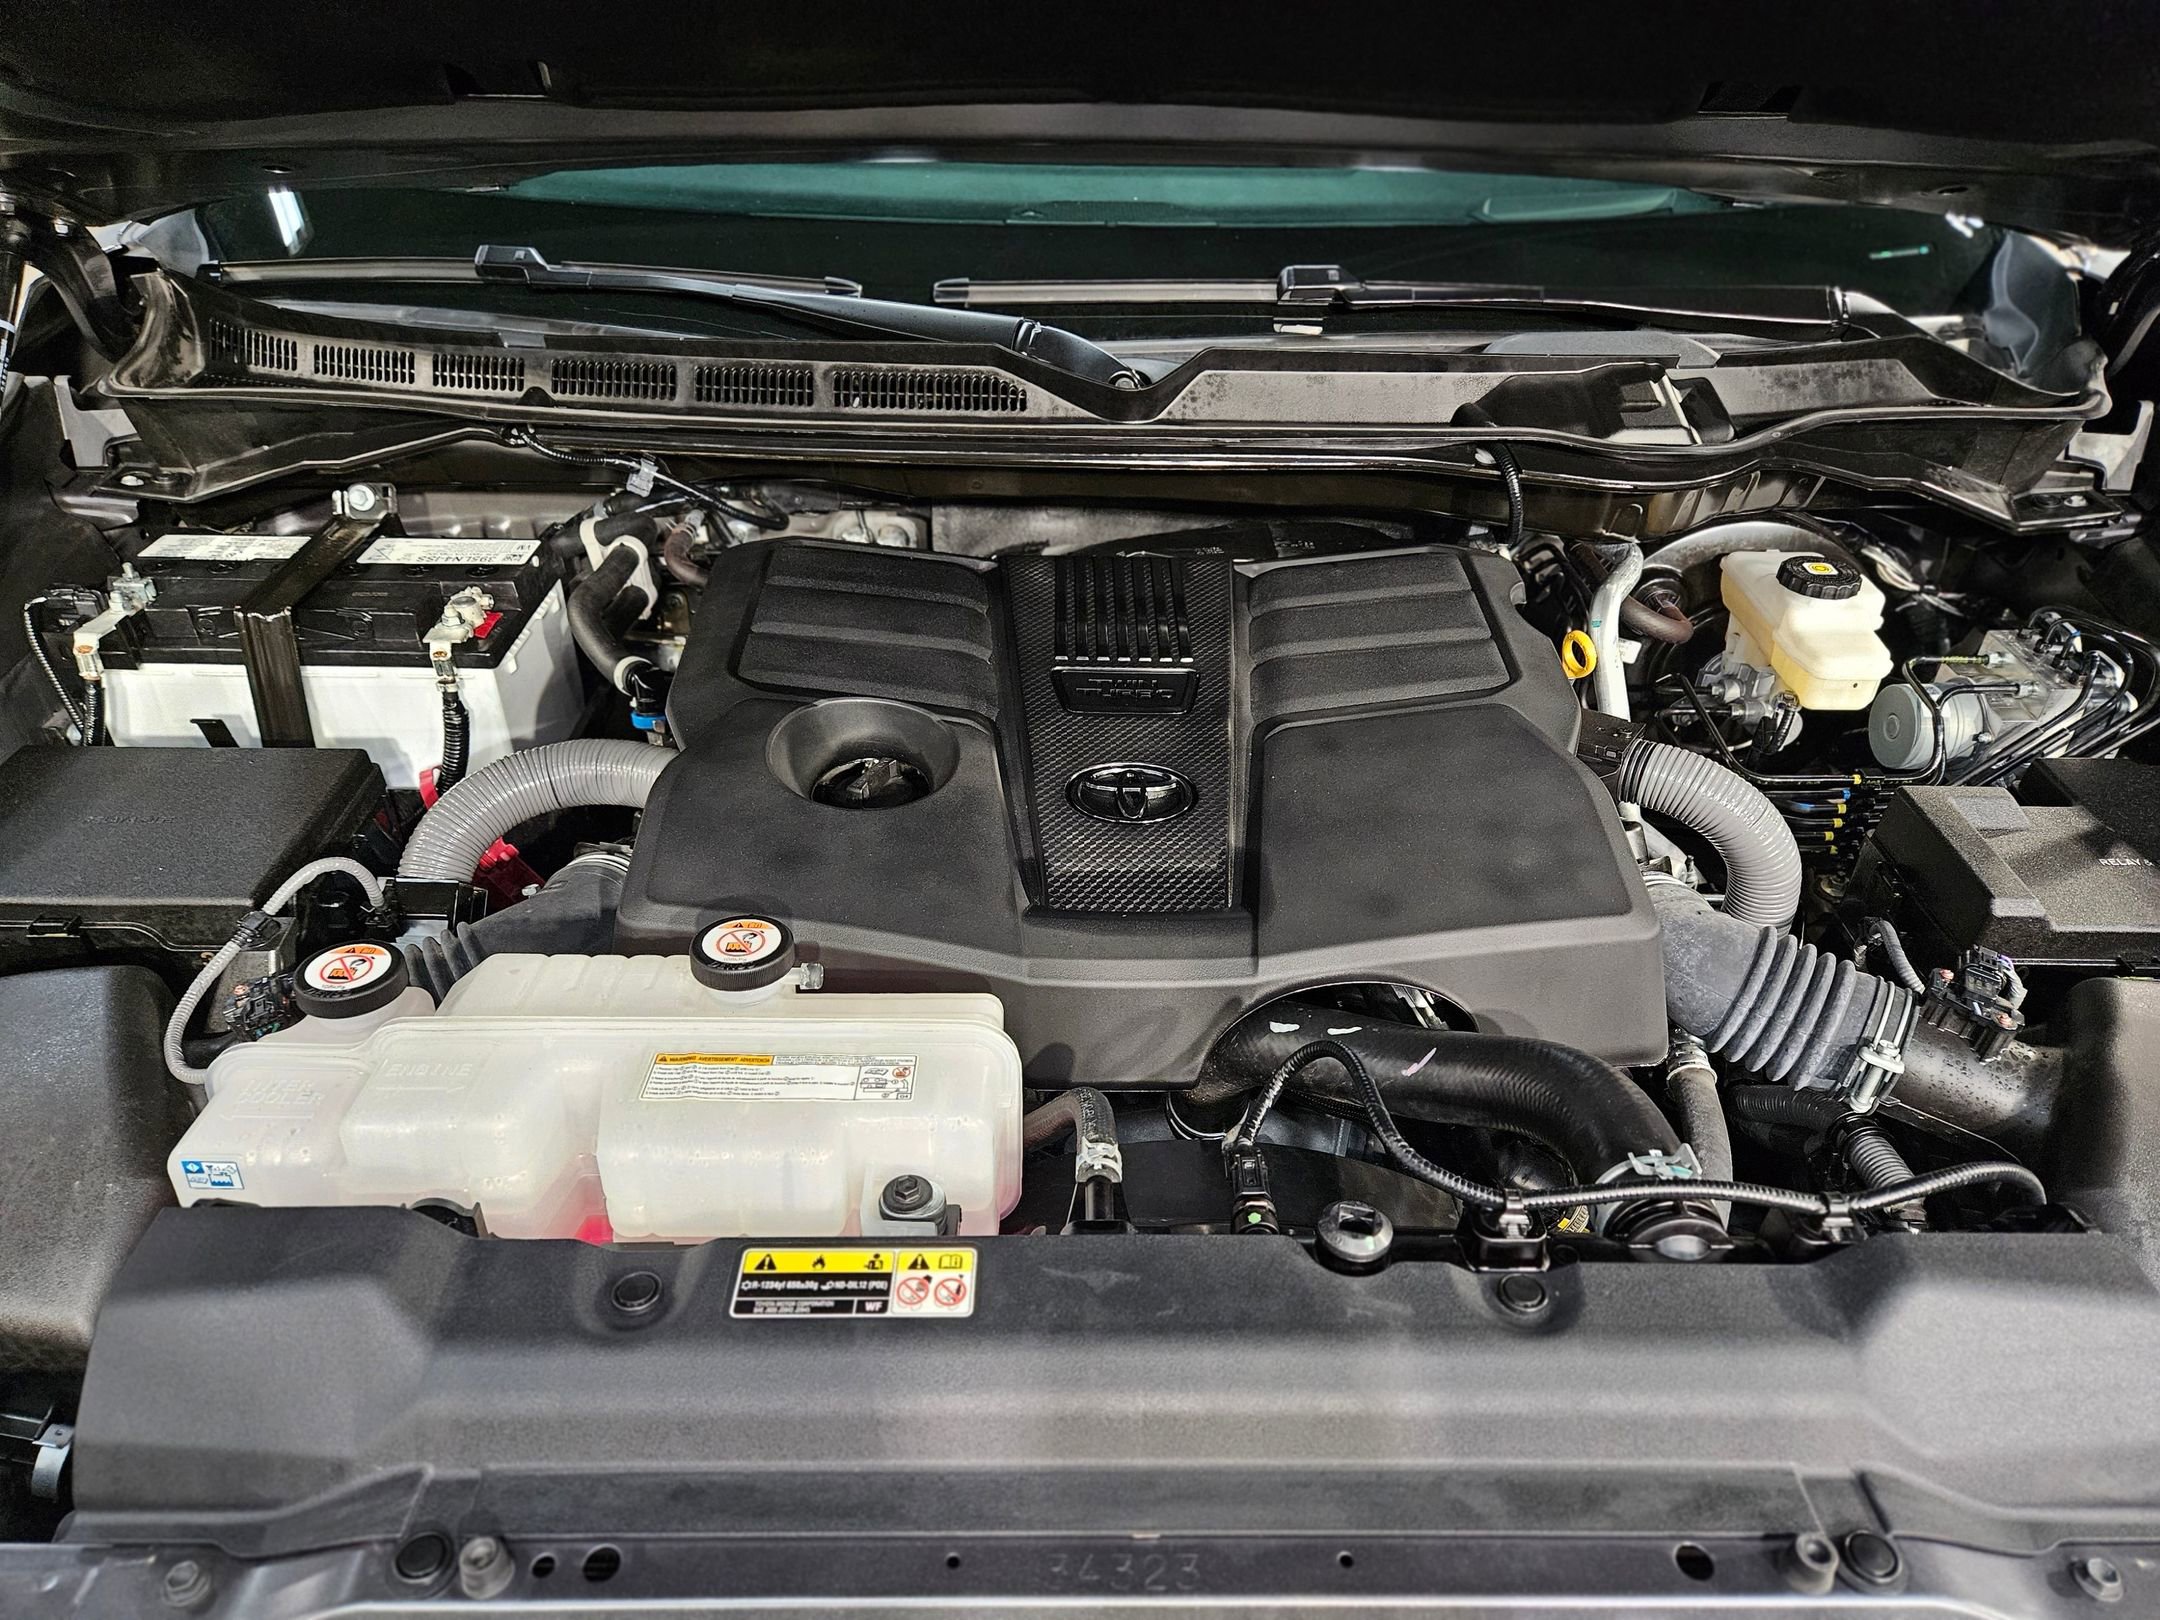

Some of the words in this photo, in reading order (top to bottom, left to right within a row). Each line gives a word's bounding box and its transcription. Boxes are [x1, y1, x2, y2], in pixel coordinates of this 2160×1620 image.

[1088, 678, 1158, 688] TWIN
[1076, 688, 1177, 700] TURBO
[2098, 858, 2142, 866] RELAY
[385, 1063, 474, 1078] ENGINE
[865, 1301, 883, 1312] WF
